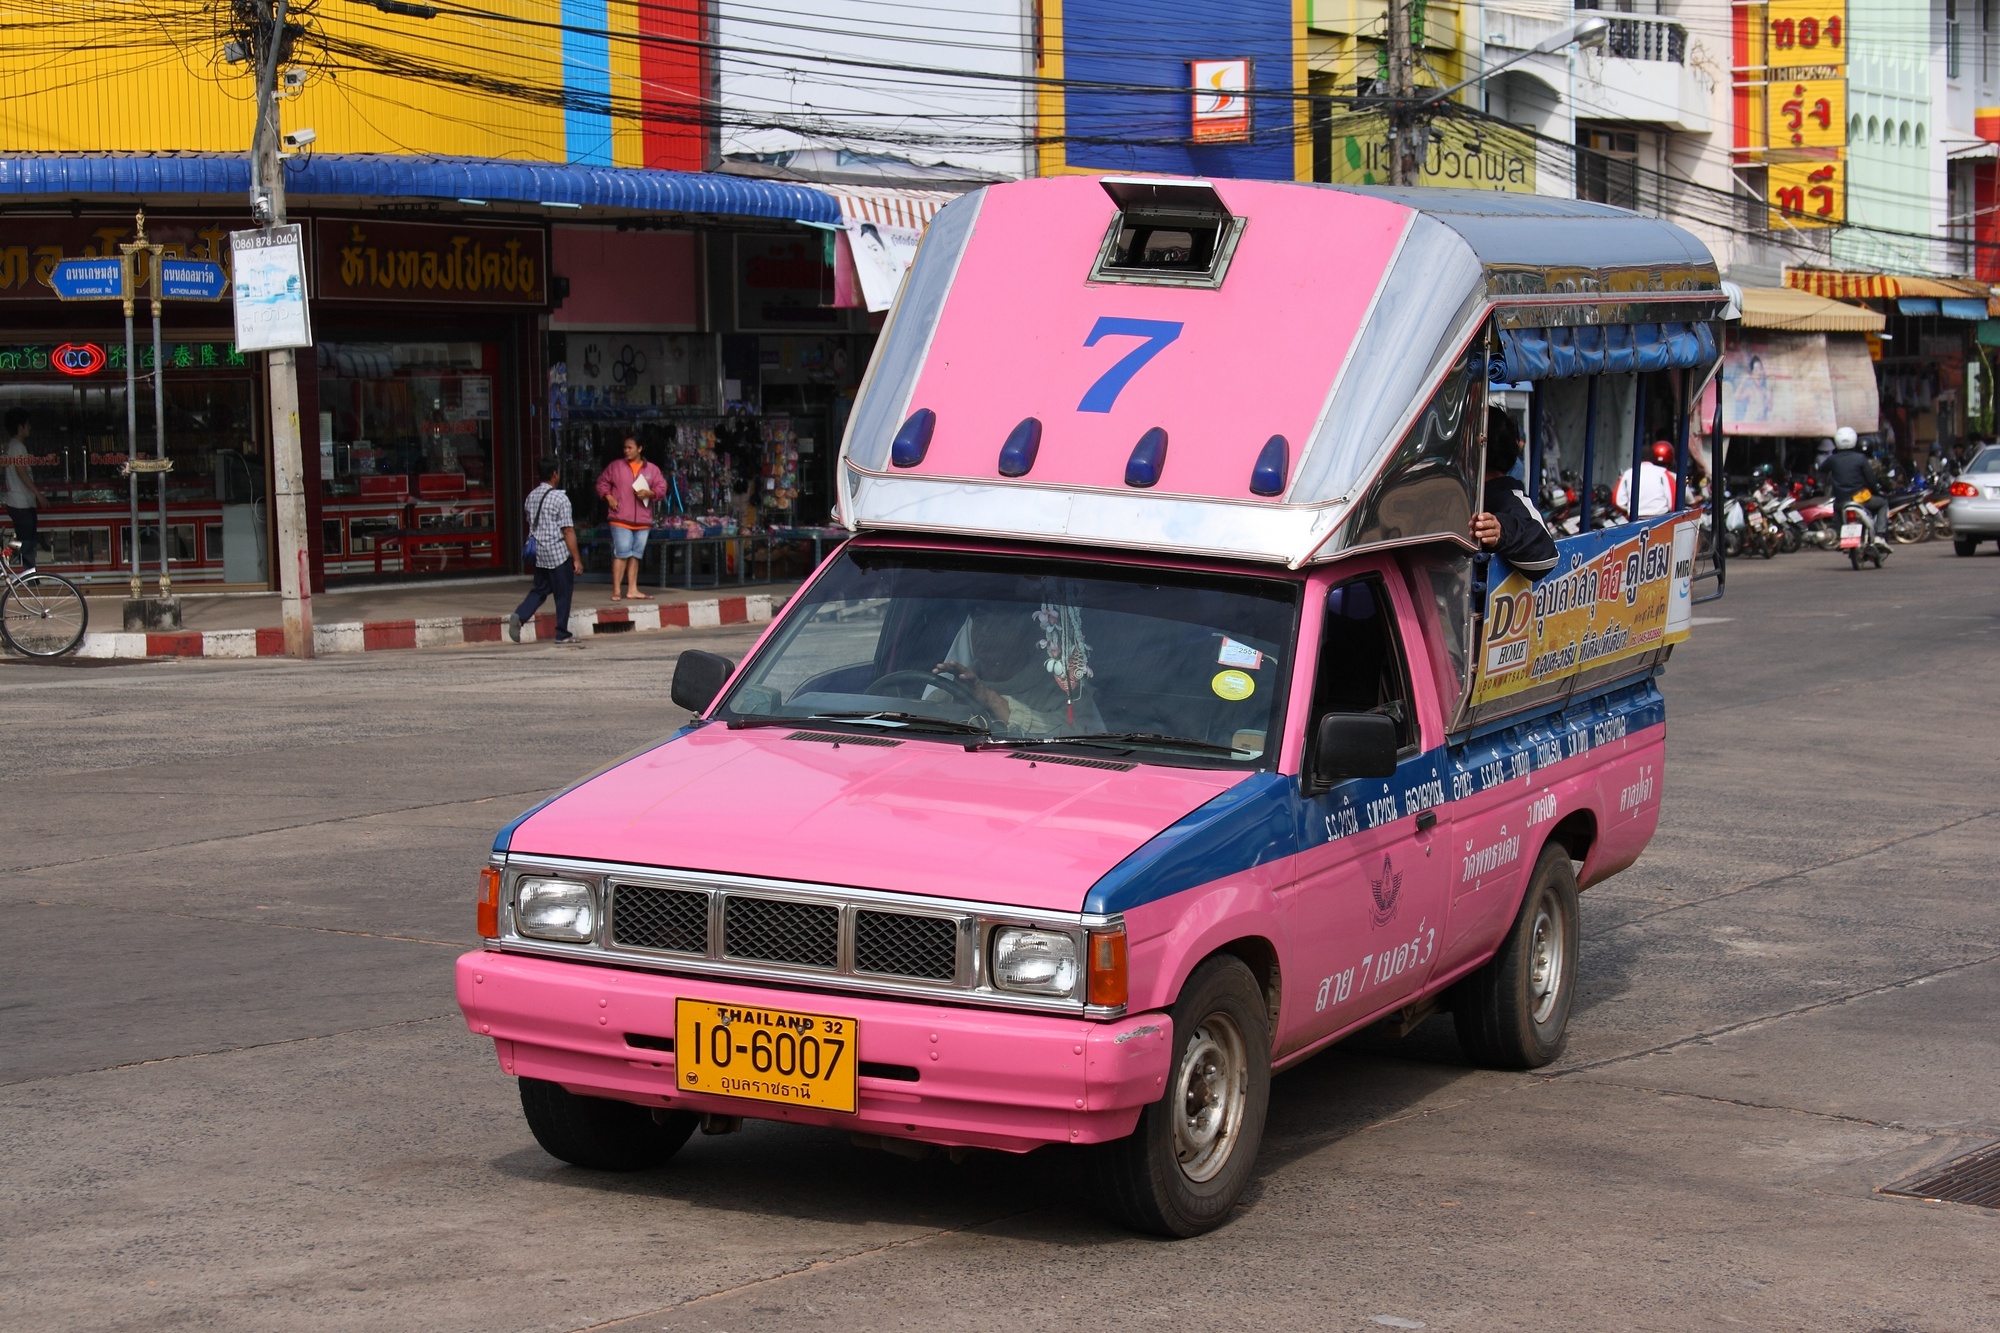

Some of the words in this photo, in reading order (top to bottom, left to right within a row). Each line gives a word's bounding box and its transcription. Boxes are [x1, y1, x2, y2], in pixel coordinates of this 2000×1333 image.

[1771, 15, 1842, 49] ทอง
[1782, 84, 1831, 146] รุ่ง
[1776, 165, 1836, 218] ทวี
[232, 238, 254, 251] (086)
[66, 265, 119, 286] ถนนเกษมสุข
[64, 350, 91, 368] CC
[1076, 316, 1185, 413] 7
[1535, 553, 1597, 638] อุบลวัสดุ
[1598, 545, 1623, 601] คือ
[1626, 528, 1671, 607] ดูโฮม
[1487, 589, 1533, 642] DO
[1238, 647, 1257, 656] 2554
[1498, 638, 1527, 665] HOME
[1405, 768, 1445, 815] ตลาดวาริน
[1453, 761, 1474, 800] อาชีวะ
[1462, 824, 1520, 890] วัดพุทธนิคม
[1315, 966, 1355, 1012] สาย
[1359, 954, 1374, 992] 7
[717, 1007, 814, 1032] THAILAND
[824, 1020, 843, 1035] 32
[695, 1021, 845, 1081] 10-6007
[721, 1076, 811, 1100] อุบลราชธานี
